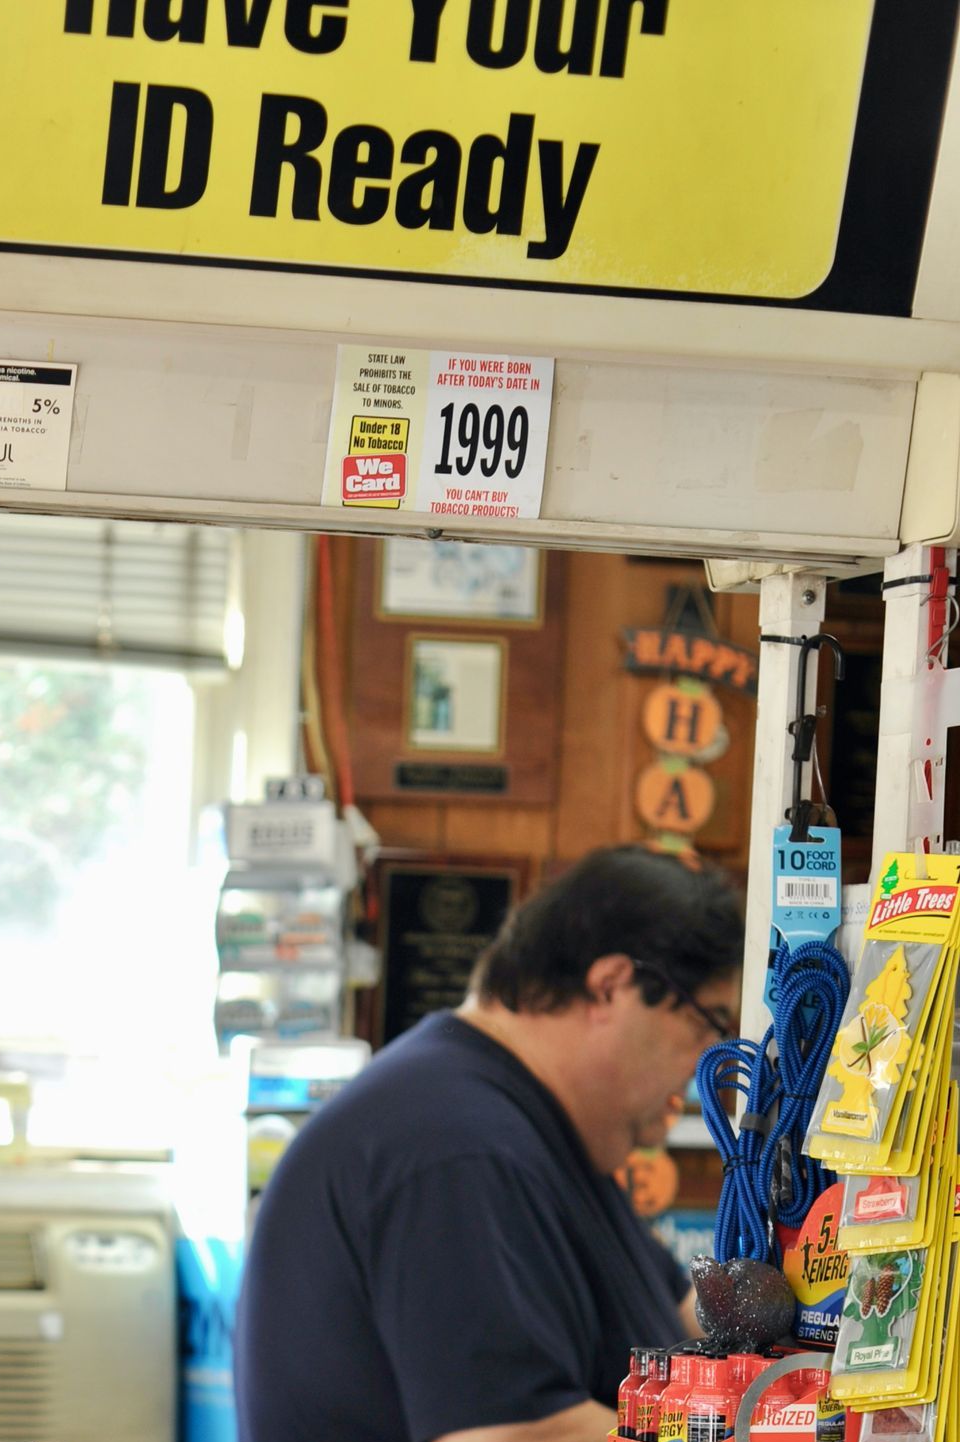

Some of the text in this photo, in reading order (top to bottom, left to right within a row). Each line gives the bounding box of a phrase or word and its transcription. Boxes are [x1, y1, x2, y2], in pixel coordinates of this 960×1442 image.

[102, 81, 601, 260] ID Ready
[368, 353, 406, 365] STATE LAW
[448, 358, 531, 375] IF YOU WERE BORN
[7, 367, 36, 376] nicotine.
[359, 368, 412, 380] PROHIBITS THE
[353, 382, 416, 396] SALE OF TOBACCO
[437, 374, 540, 391] AFTER TODAY'S DATE IN
[32, 399, 60, 415] 5%
[362, 398, 403, 410] TO MINORS.
[11, 426, 46, 434] TOBACCO
[359, 421, 400, 435] Under 18
[353, 436, 404, 451] No Tobacco
[434, 402, 529, 479] 1999
[355, 458, 393, 476] We
[346, 474, 401, 493] Card
[446, 489, 508, 503] YOU CAN'T BUY
[430, 502, 519, 518] TOBACCO PRODUCTS!
[666, 698, 700, 743] H
[656, 778, 692, 820] A
[778, 850, 834, 870] 10 FOOT
[806, 861, 836, 871] CORD
[872, 892, 909, 927] Little
[915, 888, 956, 911] Trees
[809, 1255, 848, 1284] ENERG
[800, 1310, 840, 1328] REGULA
[798, 1327, 839, 1342] STRENGT
[855, 1349, 889, 1362] Royal Pie
[660, 1424, 683, 1438] ERGY
